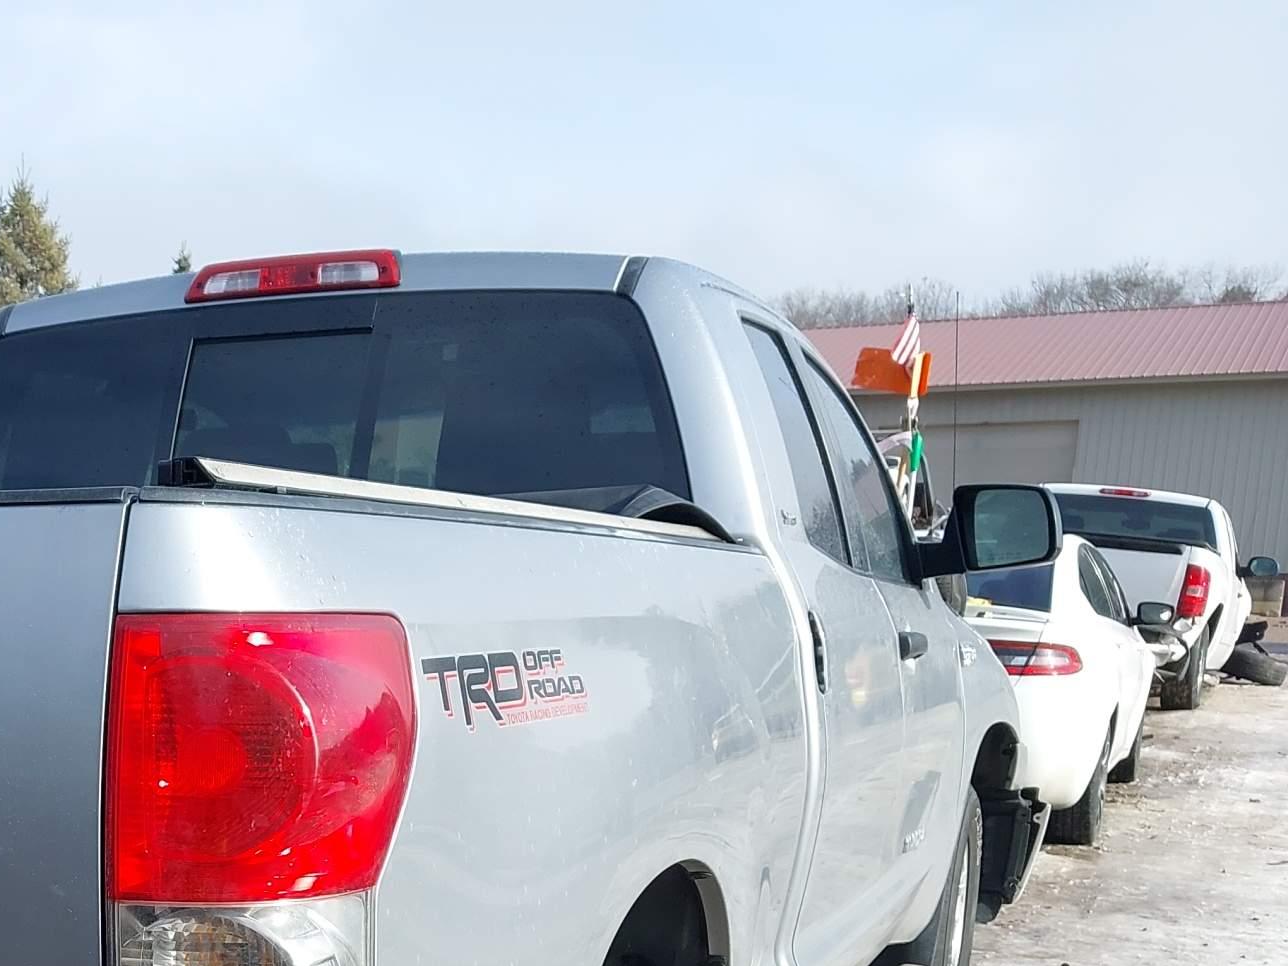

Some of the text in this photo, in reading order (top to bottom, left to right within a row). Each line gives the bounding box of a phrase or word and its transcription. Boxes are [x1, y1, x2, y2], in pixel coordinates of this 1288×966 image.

[522, 649, 563, 674] OFF
[421, 652, 525, 729] TRD
[527, 675, 587, 701] ROAD
